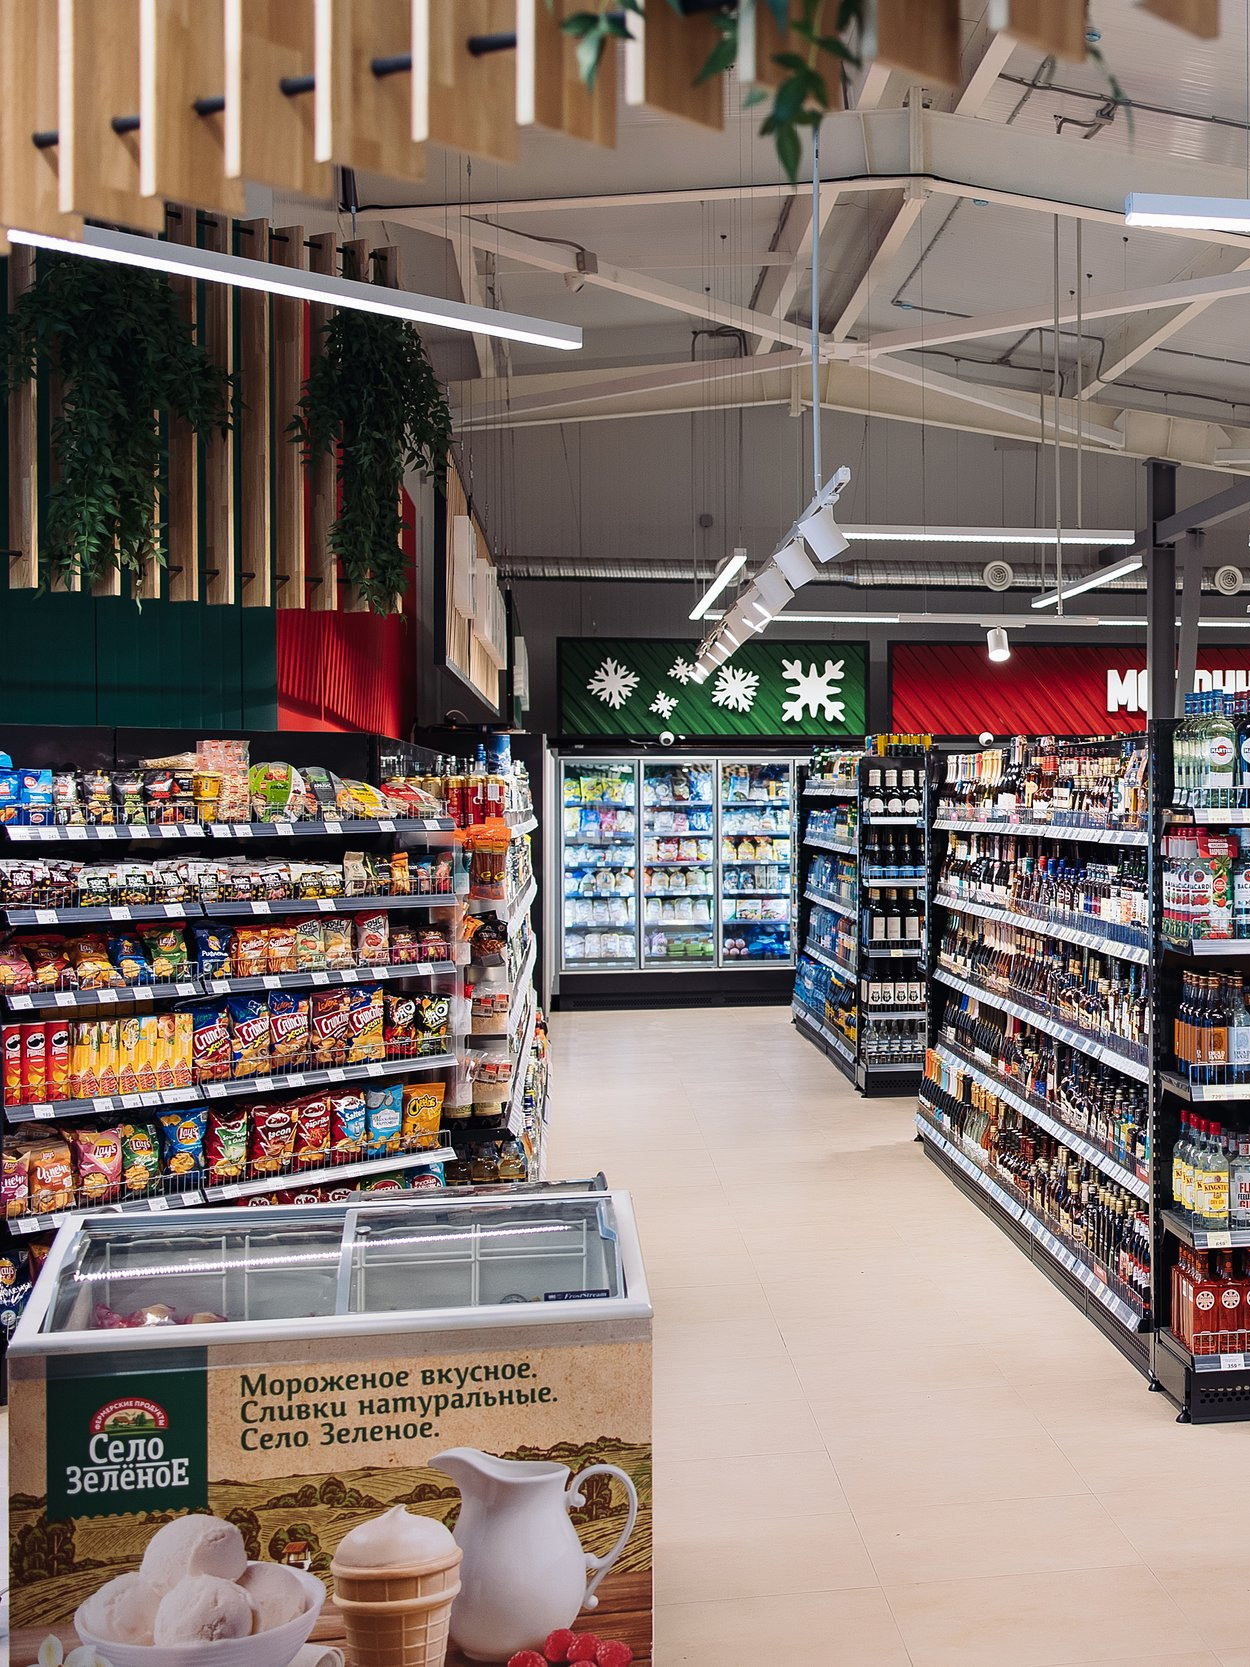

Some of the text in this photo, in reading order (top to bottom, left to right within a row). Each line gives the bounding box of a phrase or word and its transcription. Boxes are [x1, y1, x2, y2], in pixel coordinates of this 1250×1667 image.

[277, 1013, 308, 1032] Crunchi
[408, 1094, 438, 1117] Cheetos
[240, 1362, 538, 1400] Мороженое вкусное.
[95, 1400, 165, 1430] ФЕРМЕРСКИЕ ПРОДУКТЫ
[240, 1386, 558, 1424] Сливки натуральные.
[89, 1433, 165, 1464] Село
[240, 1420, 440, 1451] Село Зеленое.
